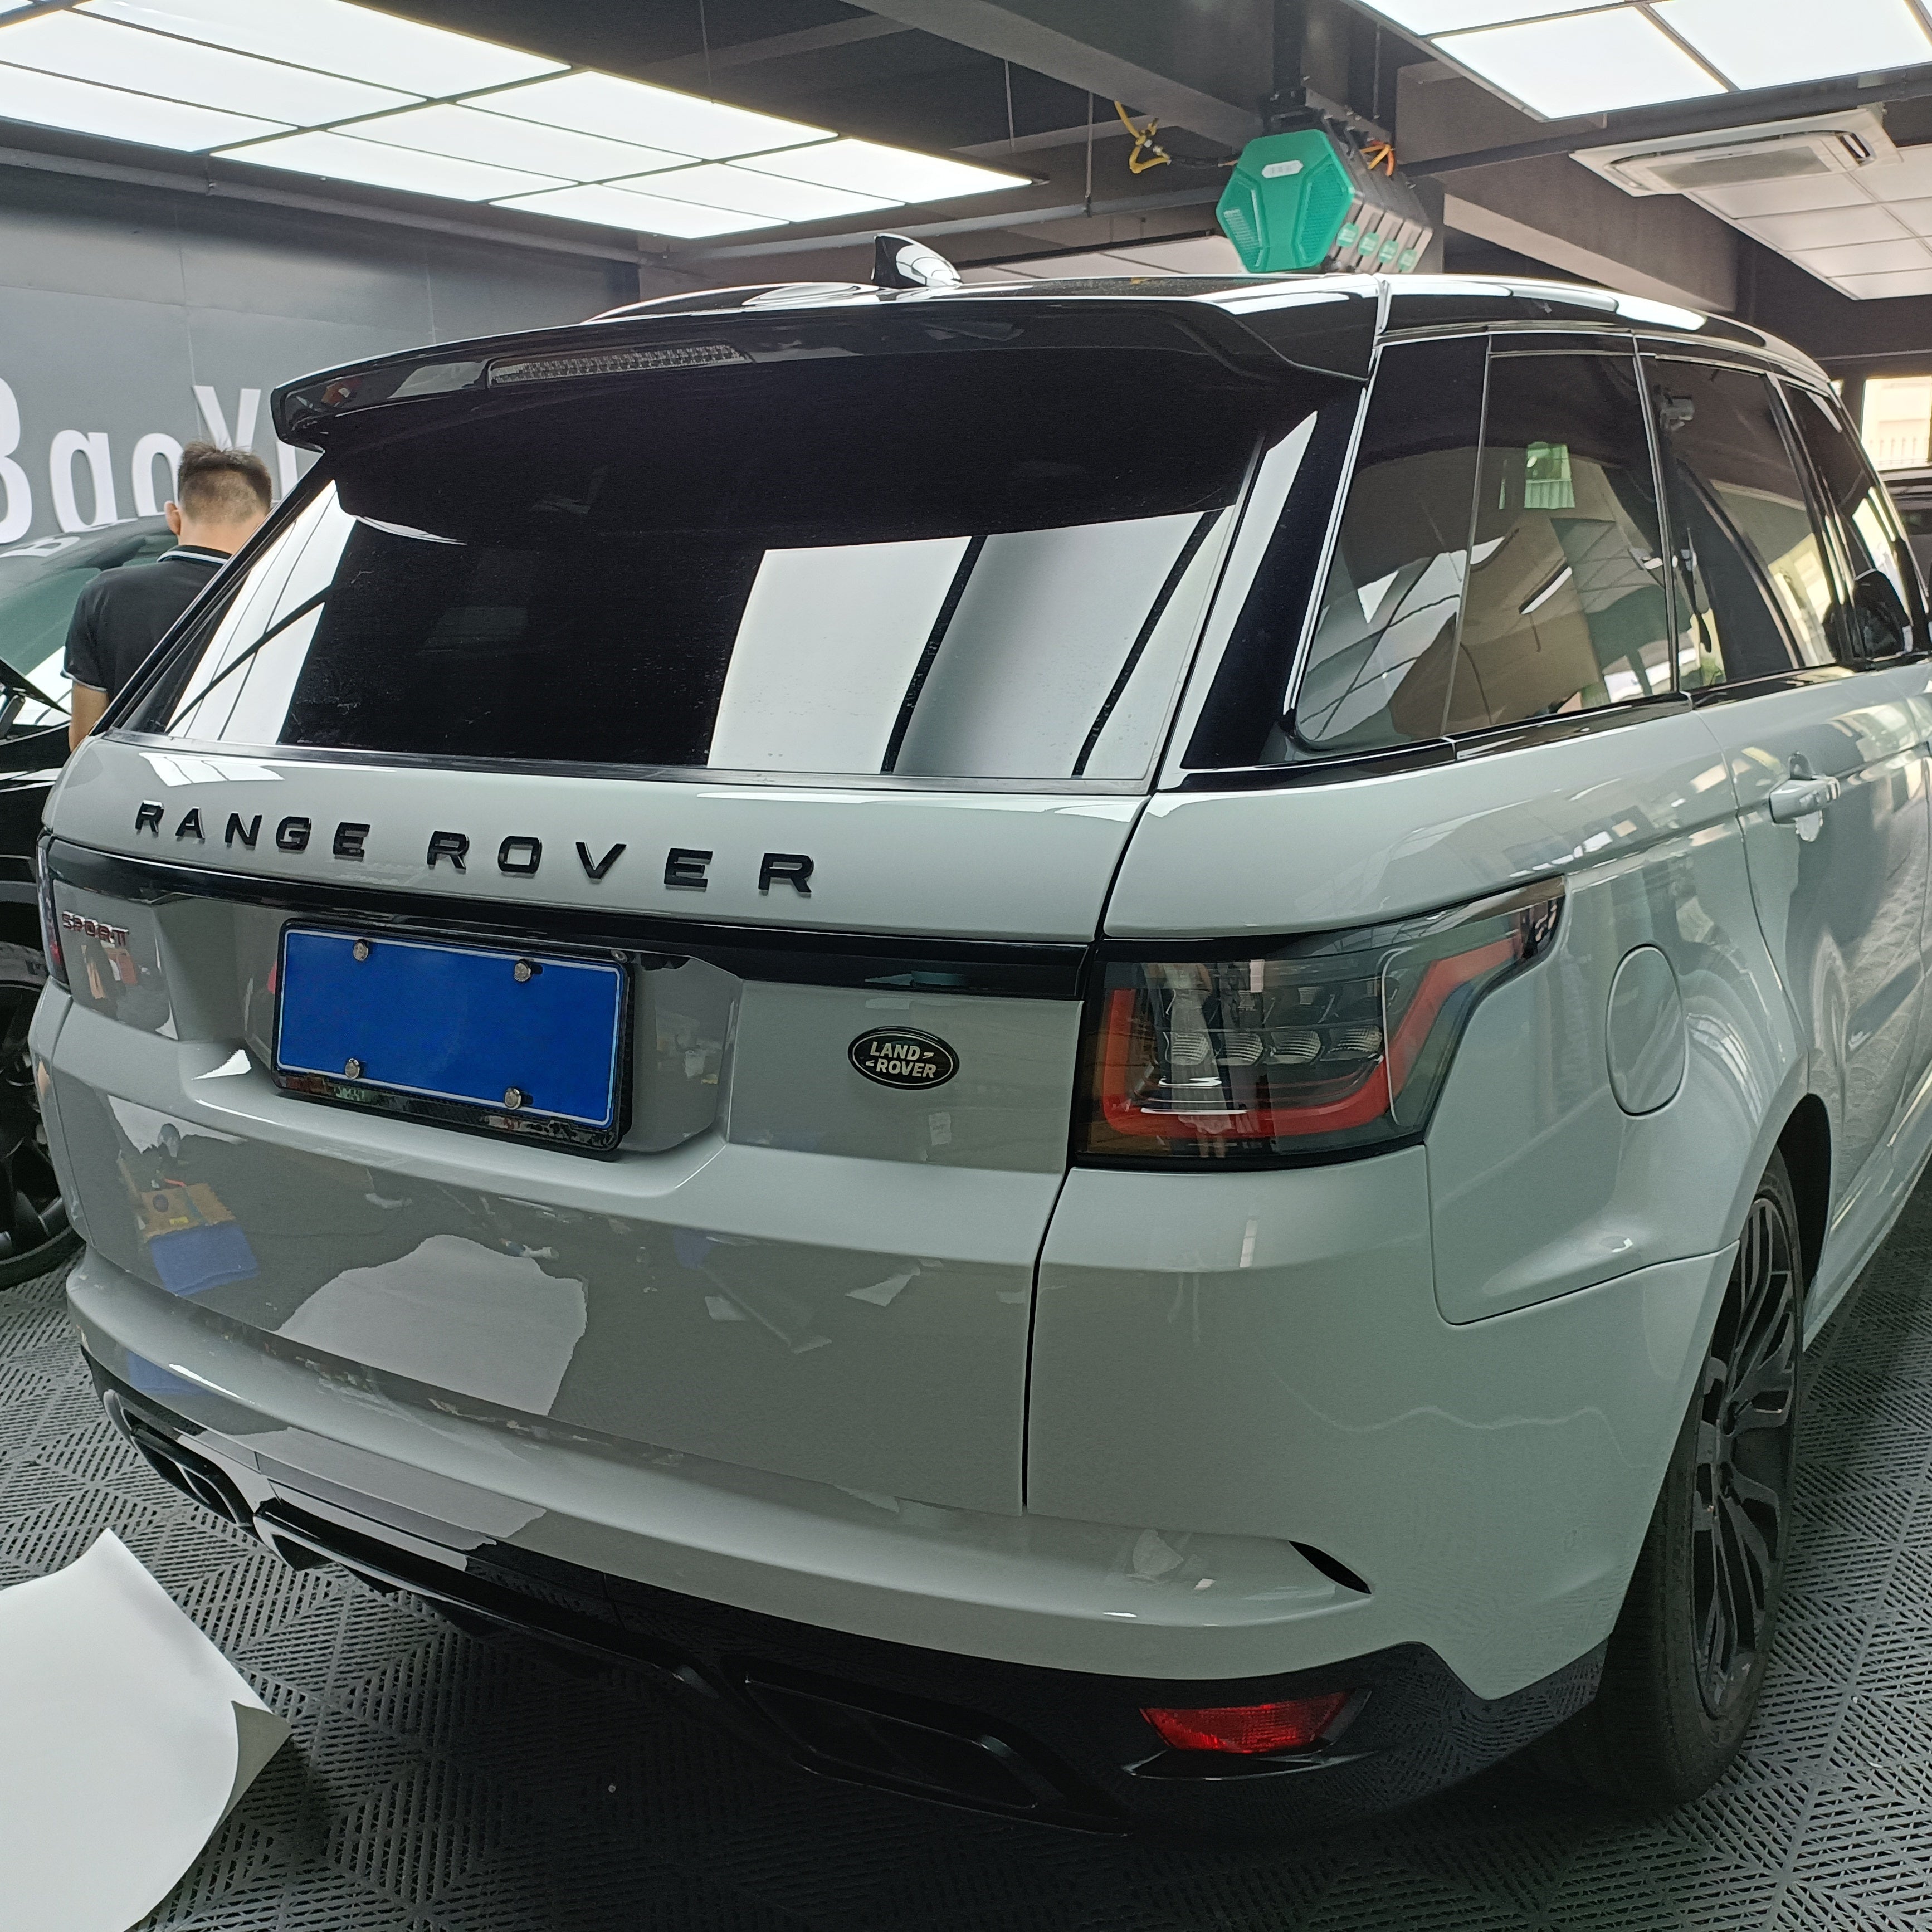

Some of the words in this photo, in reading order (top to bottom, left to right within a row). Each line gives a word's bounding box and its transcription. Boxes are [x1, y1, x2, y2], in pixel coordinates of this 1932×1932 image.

[135, 800, 370, 859] RANGE
[427, 830, 814, 894] ROVER
[62, 911, 129, 946] SPORT
[870, 1041, 920, 1060] LAND
[876, 1058, 936, 1078] ROVER
